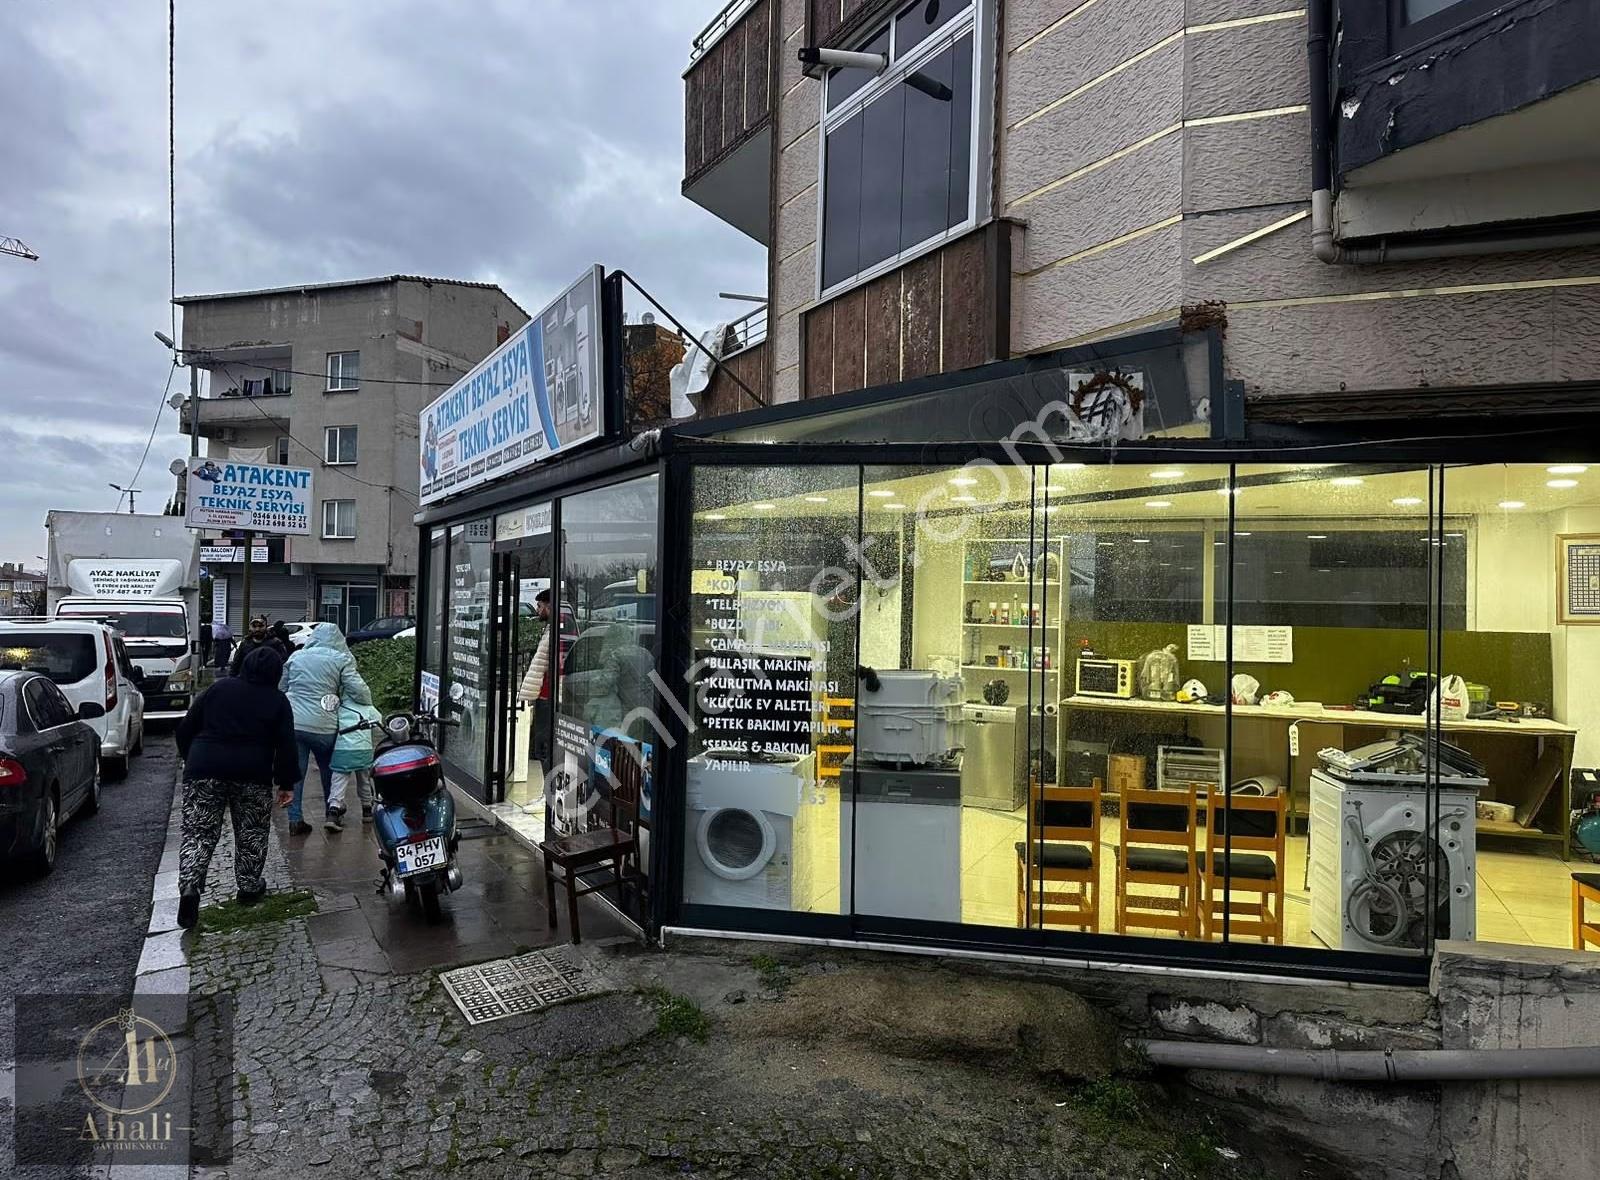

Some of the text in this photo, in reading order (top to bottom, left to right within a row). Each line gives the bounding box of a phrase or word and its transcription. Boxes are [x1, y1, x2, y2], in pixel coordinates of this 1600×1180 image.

[437, 340, 528, 434] ATAKENT BEYAZ EŞYA
[459, 410, 490, 461] TEKNİK
[492, 381, 530, 446] SERVİSİ
[223, 464, 311, 489] ATAKENT
[213, 484, 293, 502] BEYAZ EŞYA
[198, 496, 305, 514] TEKNİK SERVİSİ
[716, 560, 787, 575] BEYAZ EŞYA
[709, 657, 827, 673] BULAŞIK MAKİNASI
[709, 678, 839, 693] KURUTMA MAKİNASI
[756, 699, 772, 710] EV
[708, 717, 840, 734] PETEK BAKIMI YAPILIR
[707, 737, 810, 754] SERVİS & BAKIMI
[704, 760, 751, 772] YAPILIR
[398, 838, 441, 859] 34 PHV
[414, 853, 436, 867] 057
